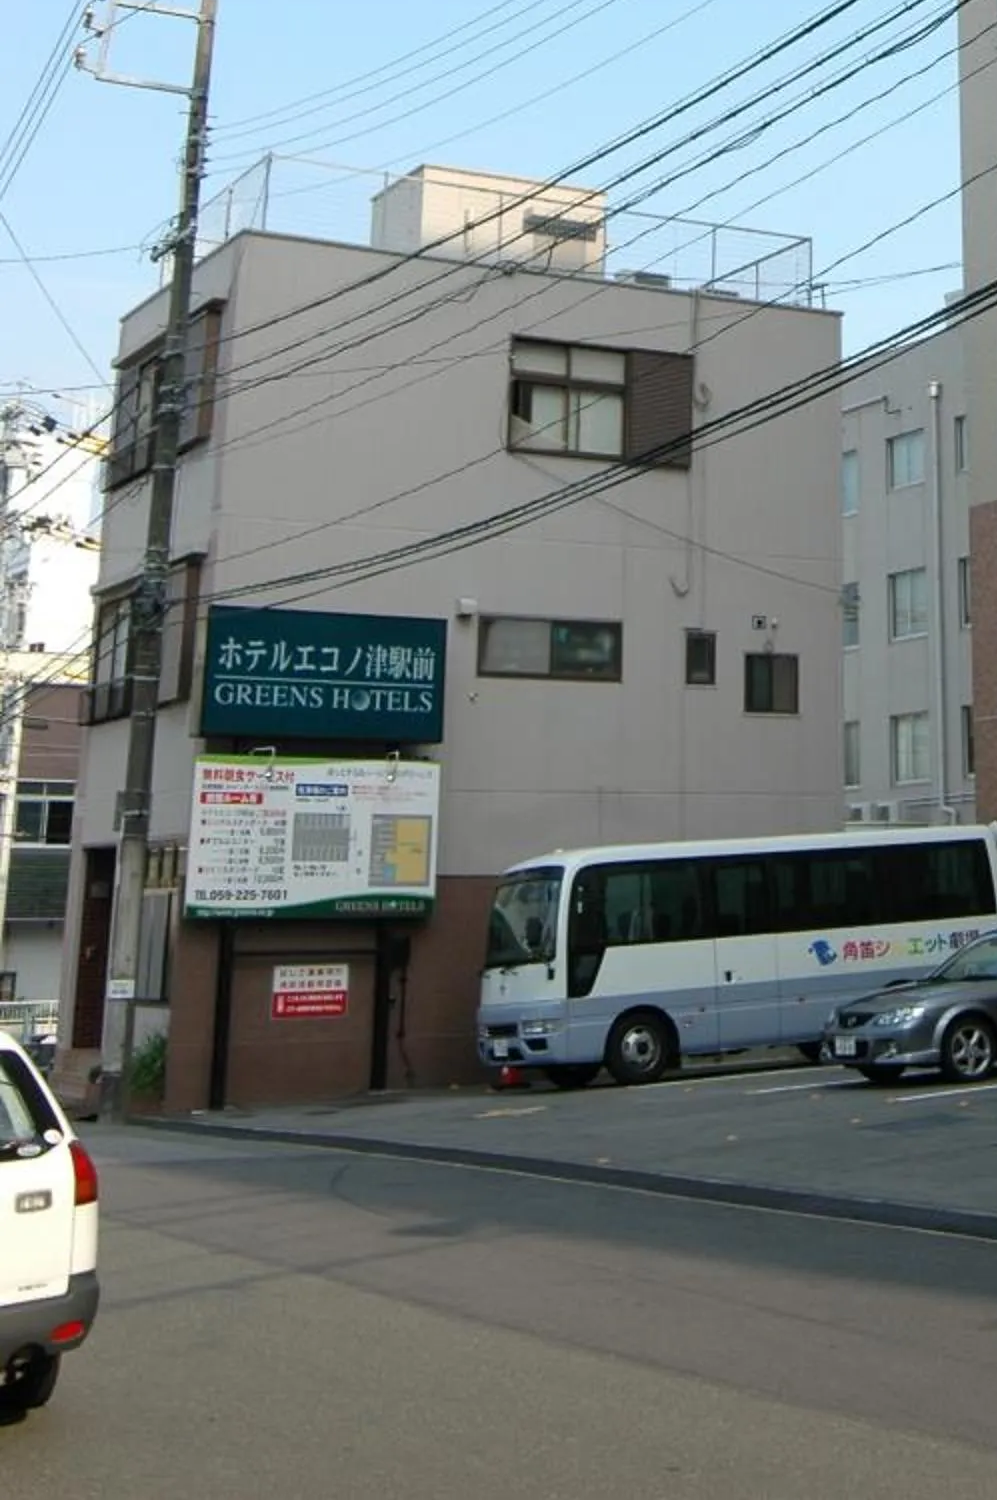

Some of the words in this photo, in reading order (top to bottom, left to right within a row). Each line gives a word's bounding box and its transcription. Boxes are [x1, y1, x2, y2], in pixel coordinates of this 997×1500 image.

[218, 636, 436, 681] ホテルエコノ津駅前
[214, 682, 324, 709] GREENS
[332, 687, 433, 714] HOTELS
[842, 930, 979, 961] 角笛シエット劇
